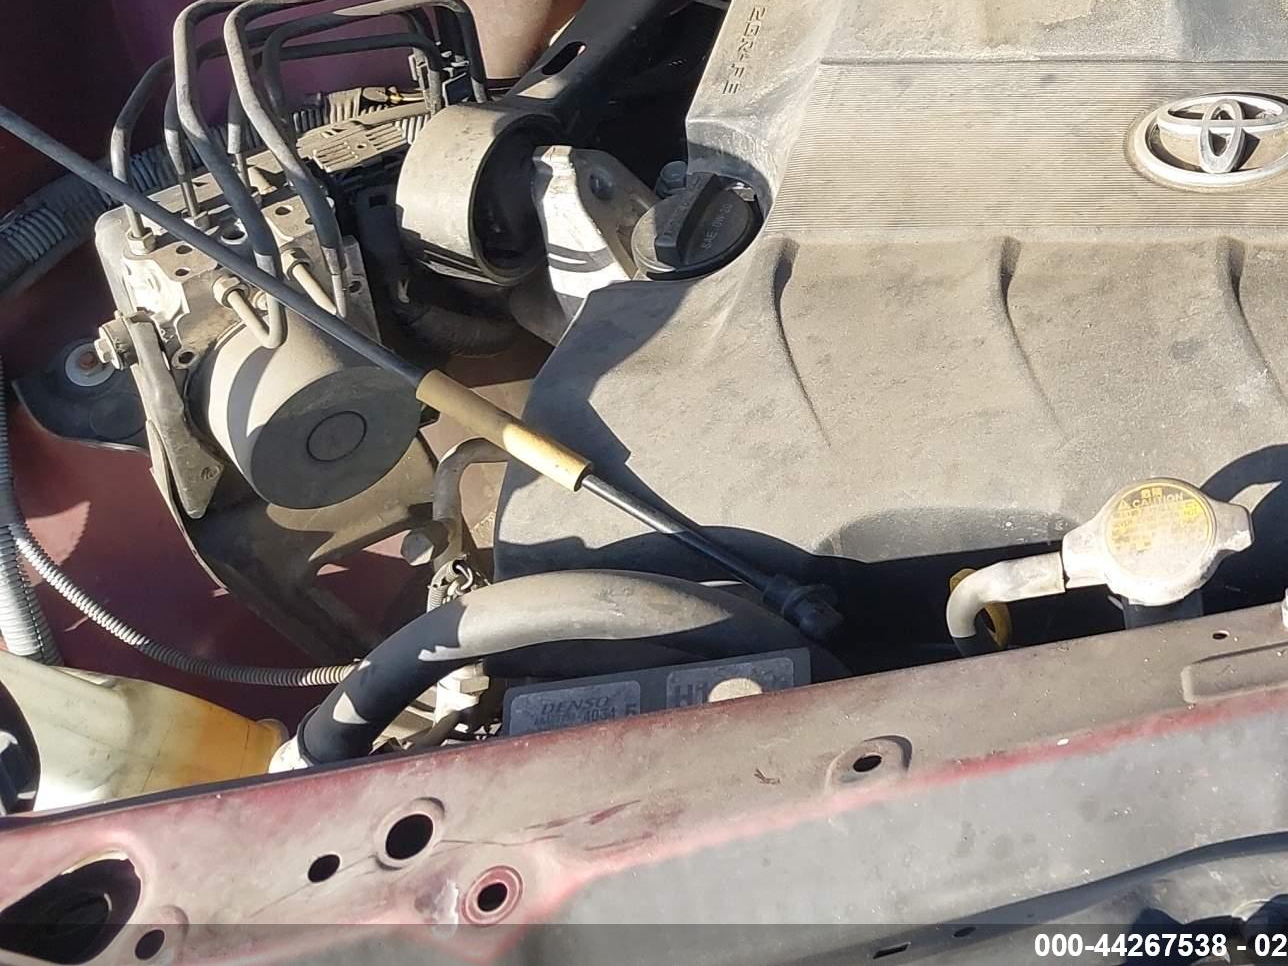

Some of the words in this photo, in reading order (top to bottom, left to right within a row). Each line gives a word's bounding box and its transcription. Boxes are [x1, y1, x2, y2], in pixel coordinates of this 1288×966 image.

[722, 6, 766, 94] 2GR-FE
[1132, 492, 1184, 509] CAUTION
[541, 695, 609, 715] DENSO
